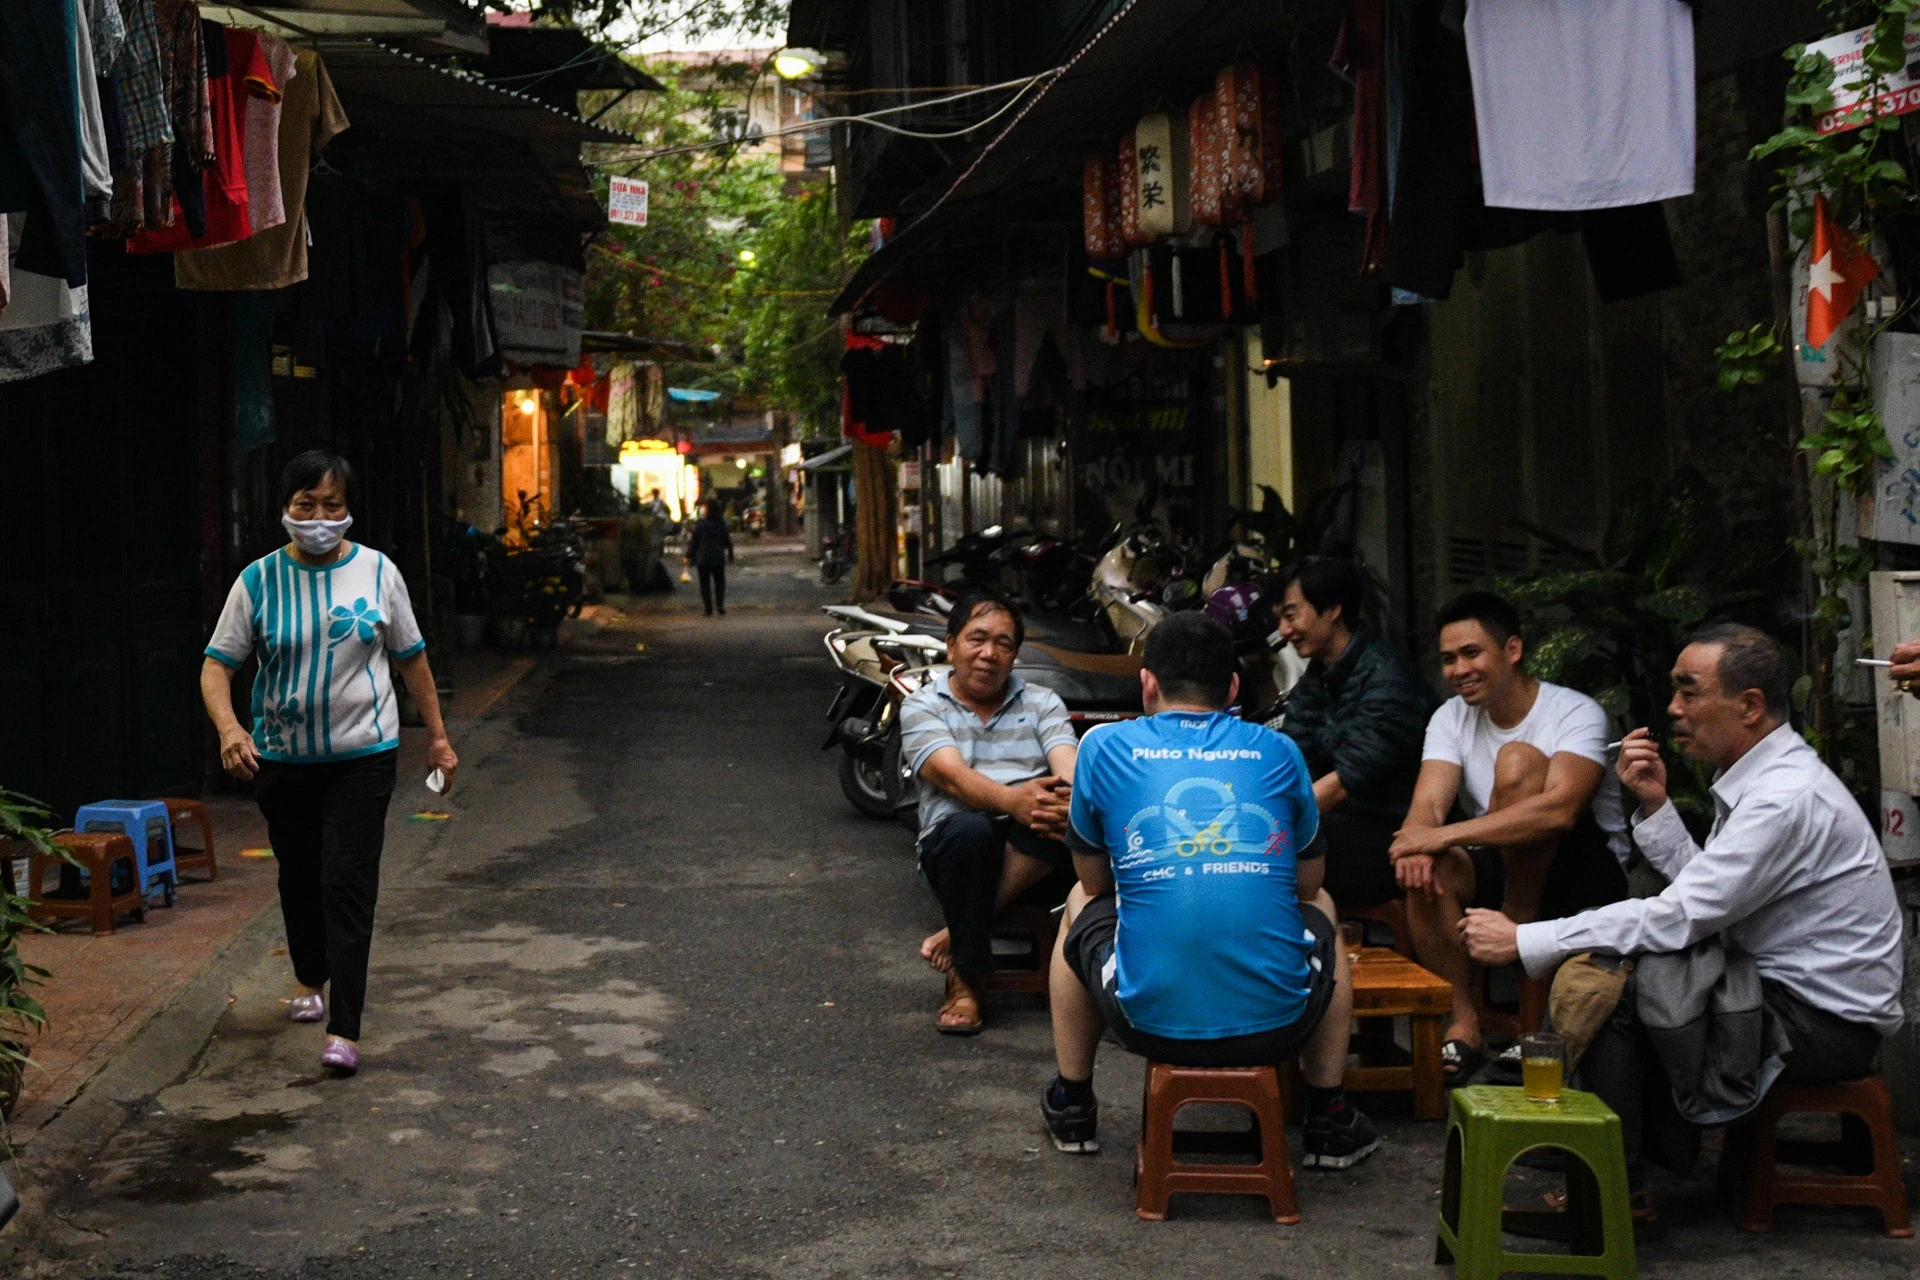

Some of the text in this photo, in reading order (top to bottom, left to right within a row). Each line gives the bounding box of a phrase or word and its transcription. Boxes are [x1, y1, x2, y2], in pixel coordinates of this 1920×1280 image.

[1084, 712, 1120, 720] HONDA
[1132, 747, 1262, 762] Pluto Nguyen
[1142, 861, 1270, 882] CMC & FRIENDS
